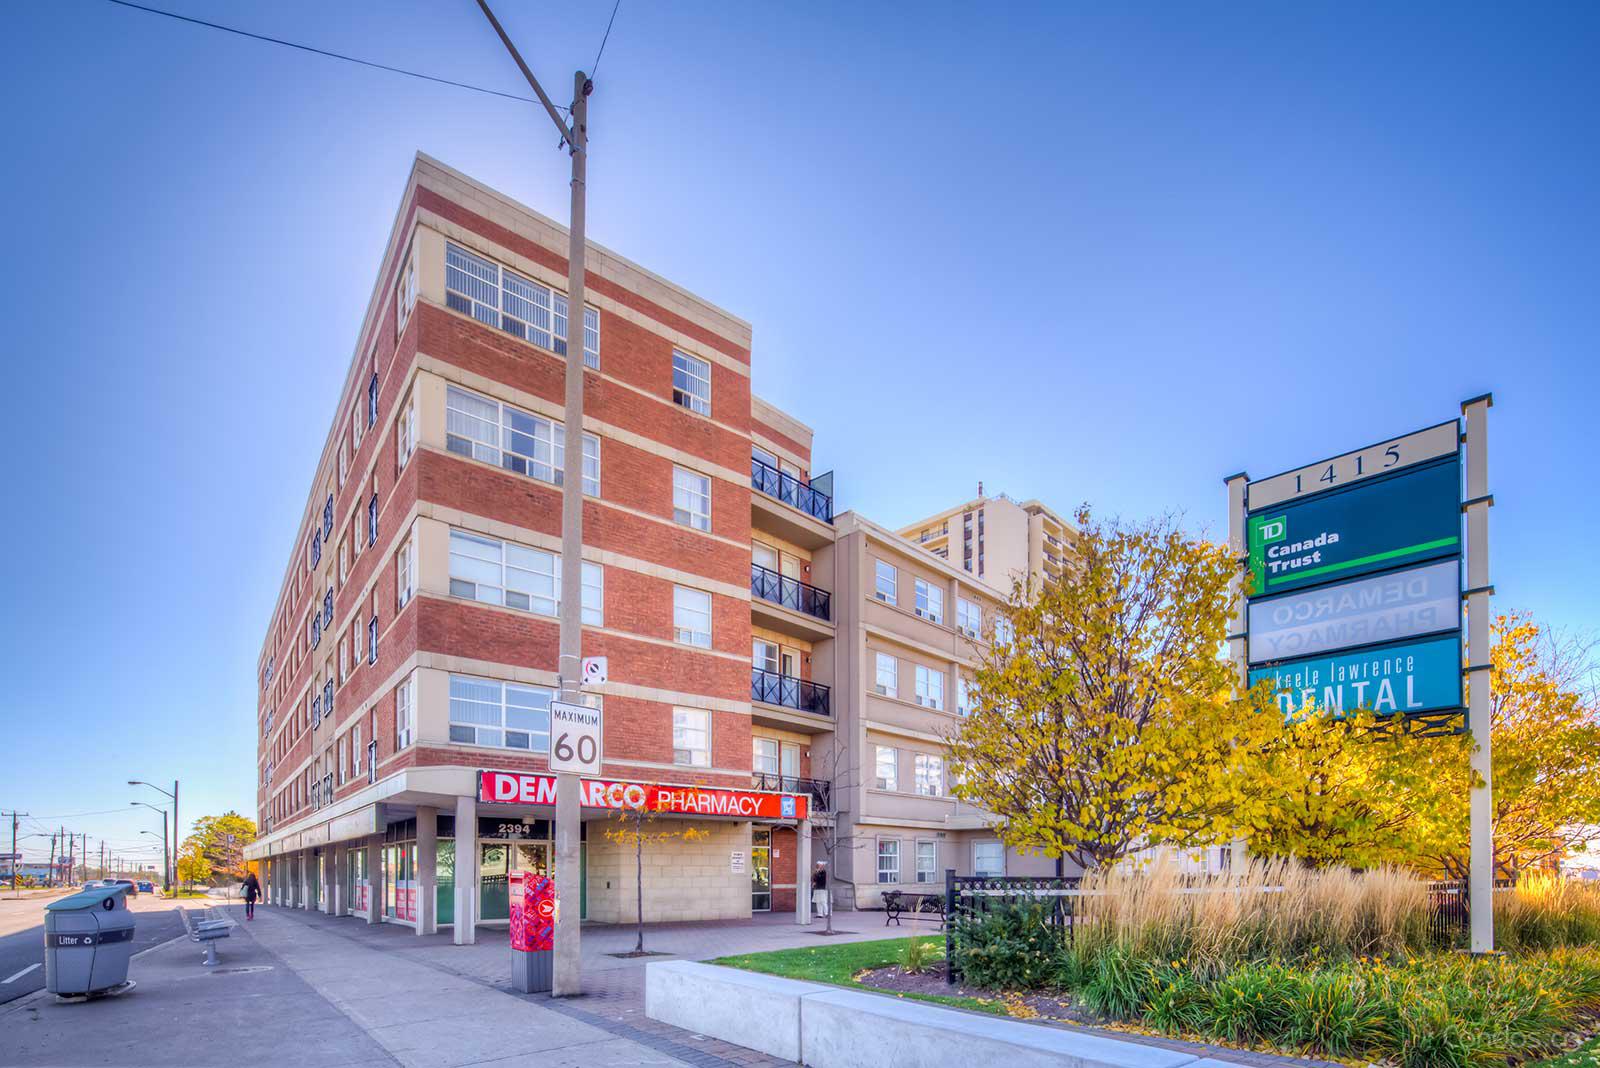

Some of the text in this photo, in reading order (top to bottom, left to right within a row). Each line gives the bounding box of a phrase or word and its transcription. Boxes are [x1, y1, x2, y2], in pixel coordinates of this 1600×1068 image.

[1295, 444, 1401, 493] 1415
[1258, 521, 1283, 541] TD
[1267, 532, 1340, 559] Canada
[1268, 551, 1322, 574] Trust
[1275, 655, 1414, 690] keele lawrence
[554, 709, 599, 726] MAXIMUM
[554, 732, 597, 765] 60
[657, 790, 763, 815] PHARMACY
[498, 823, 531, 834] 2394
[58, 935, 79, 945] Litter
